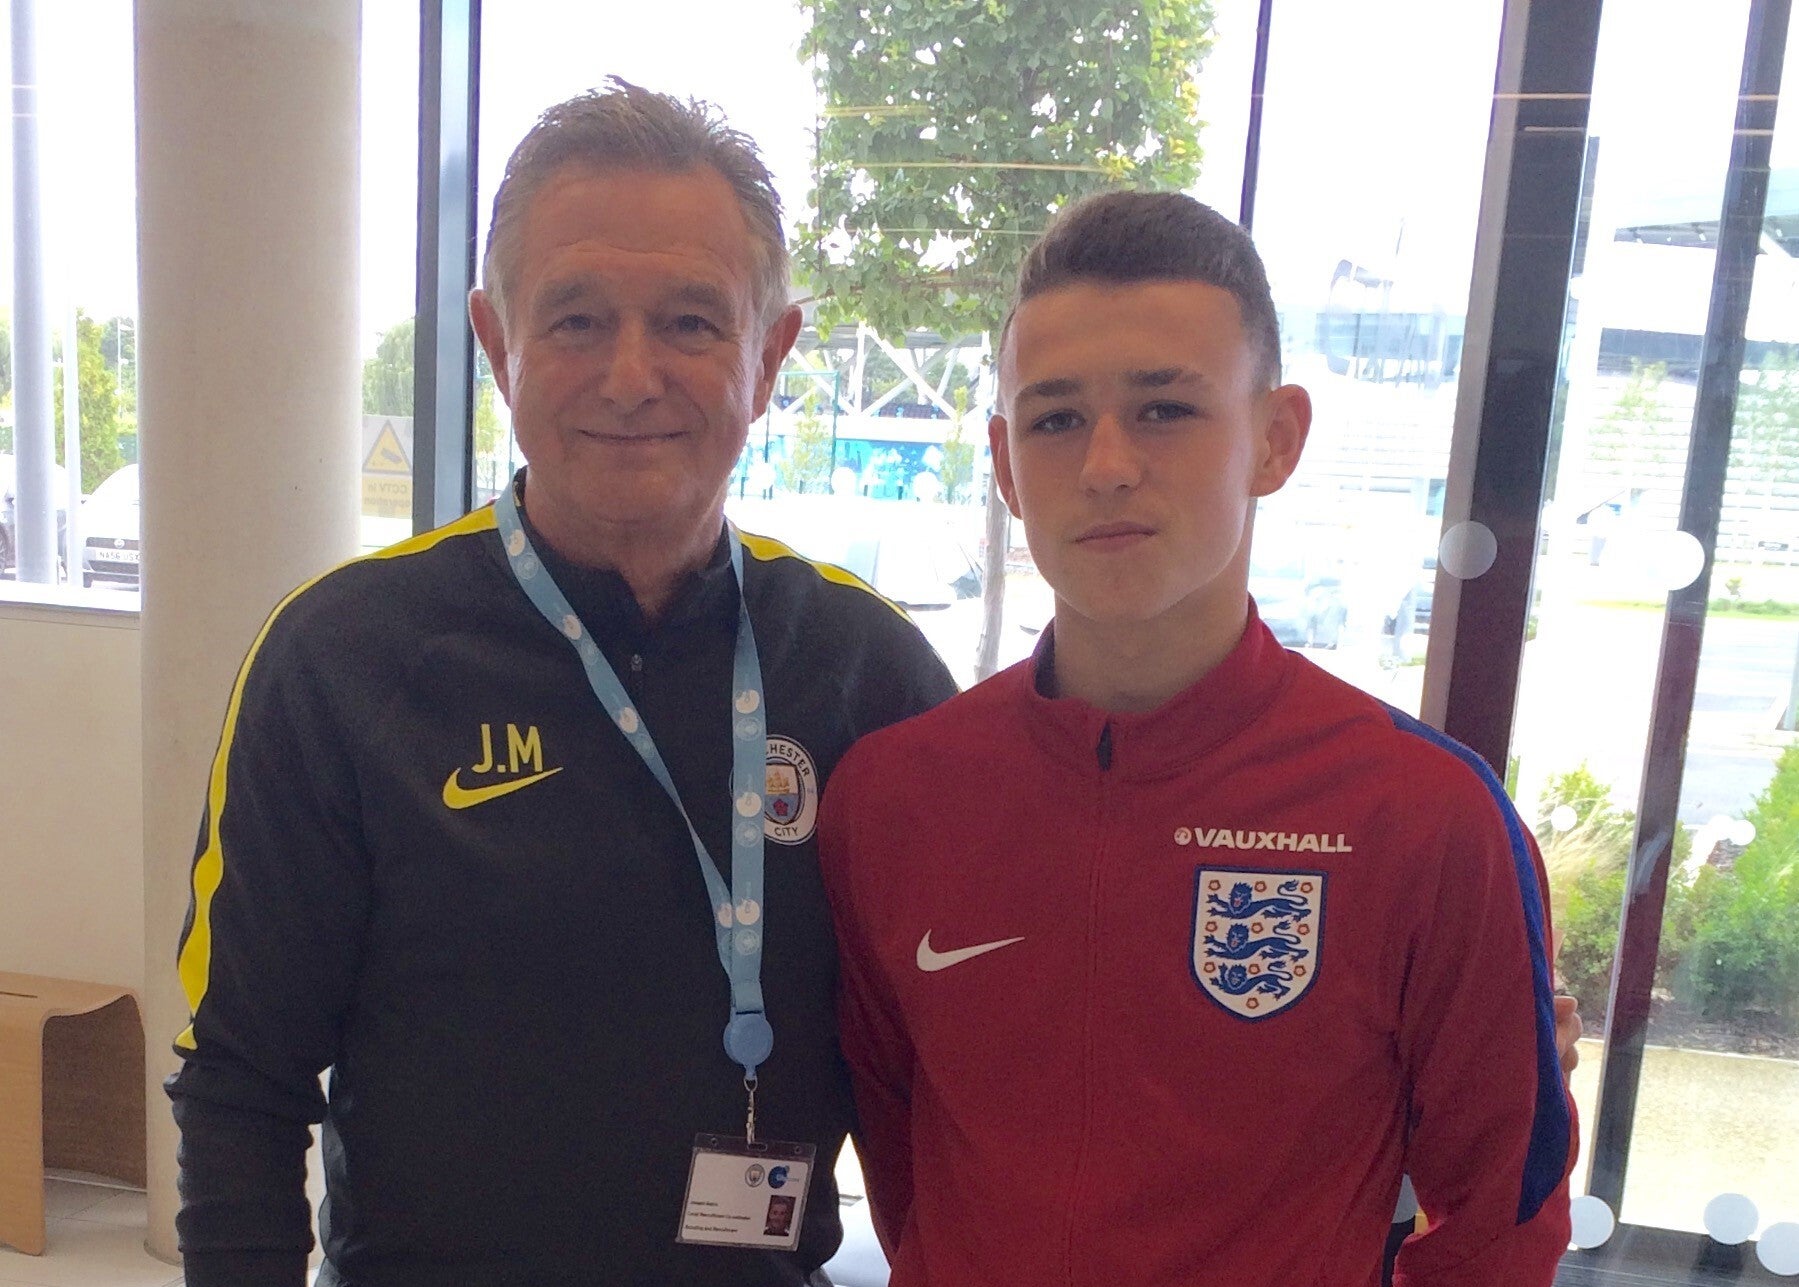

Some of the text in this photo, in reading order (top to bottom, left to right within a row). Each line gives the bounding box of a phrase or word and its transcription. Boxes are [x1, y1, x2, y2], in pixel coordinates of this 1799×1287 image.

[471, 723, 543, 773] J.M
[766, 743, 810, 777] HESTER
[774, 826, 798, 837] CITY
[1194, 827, 1352, 853] VAUXHALL
